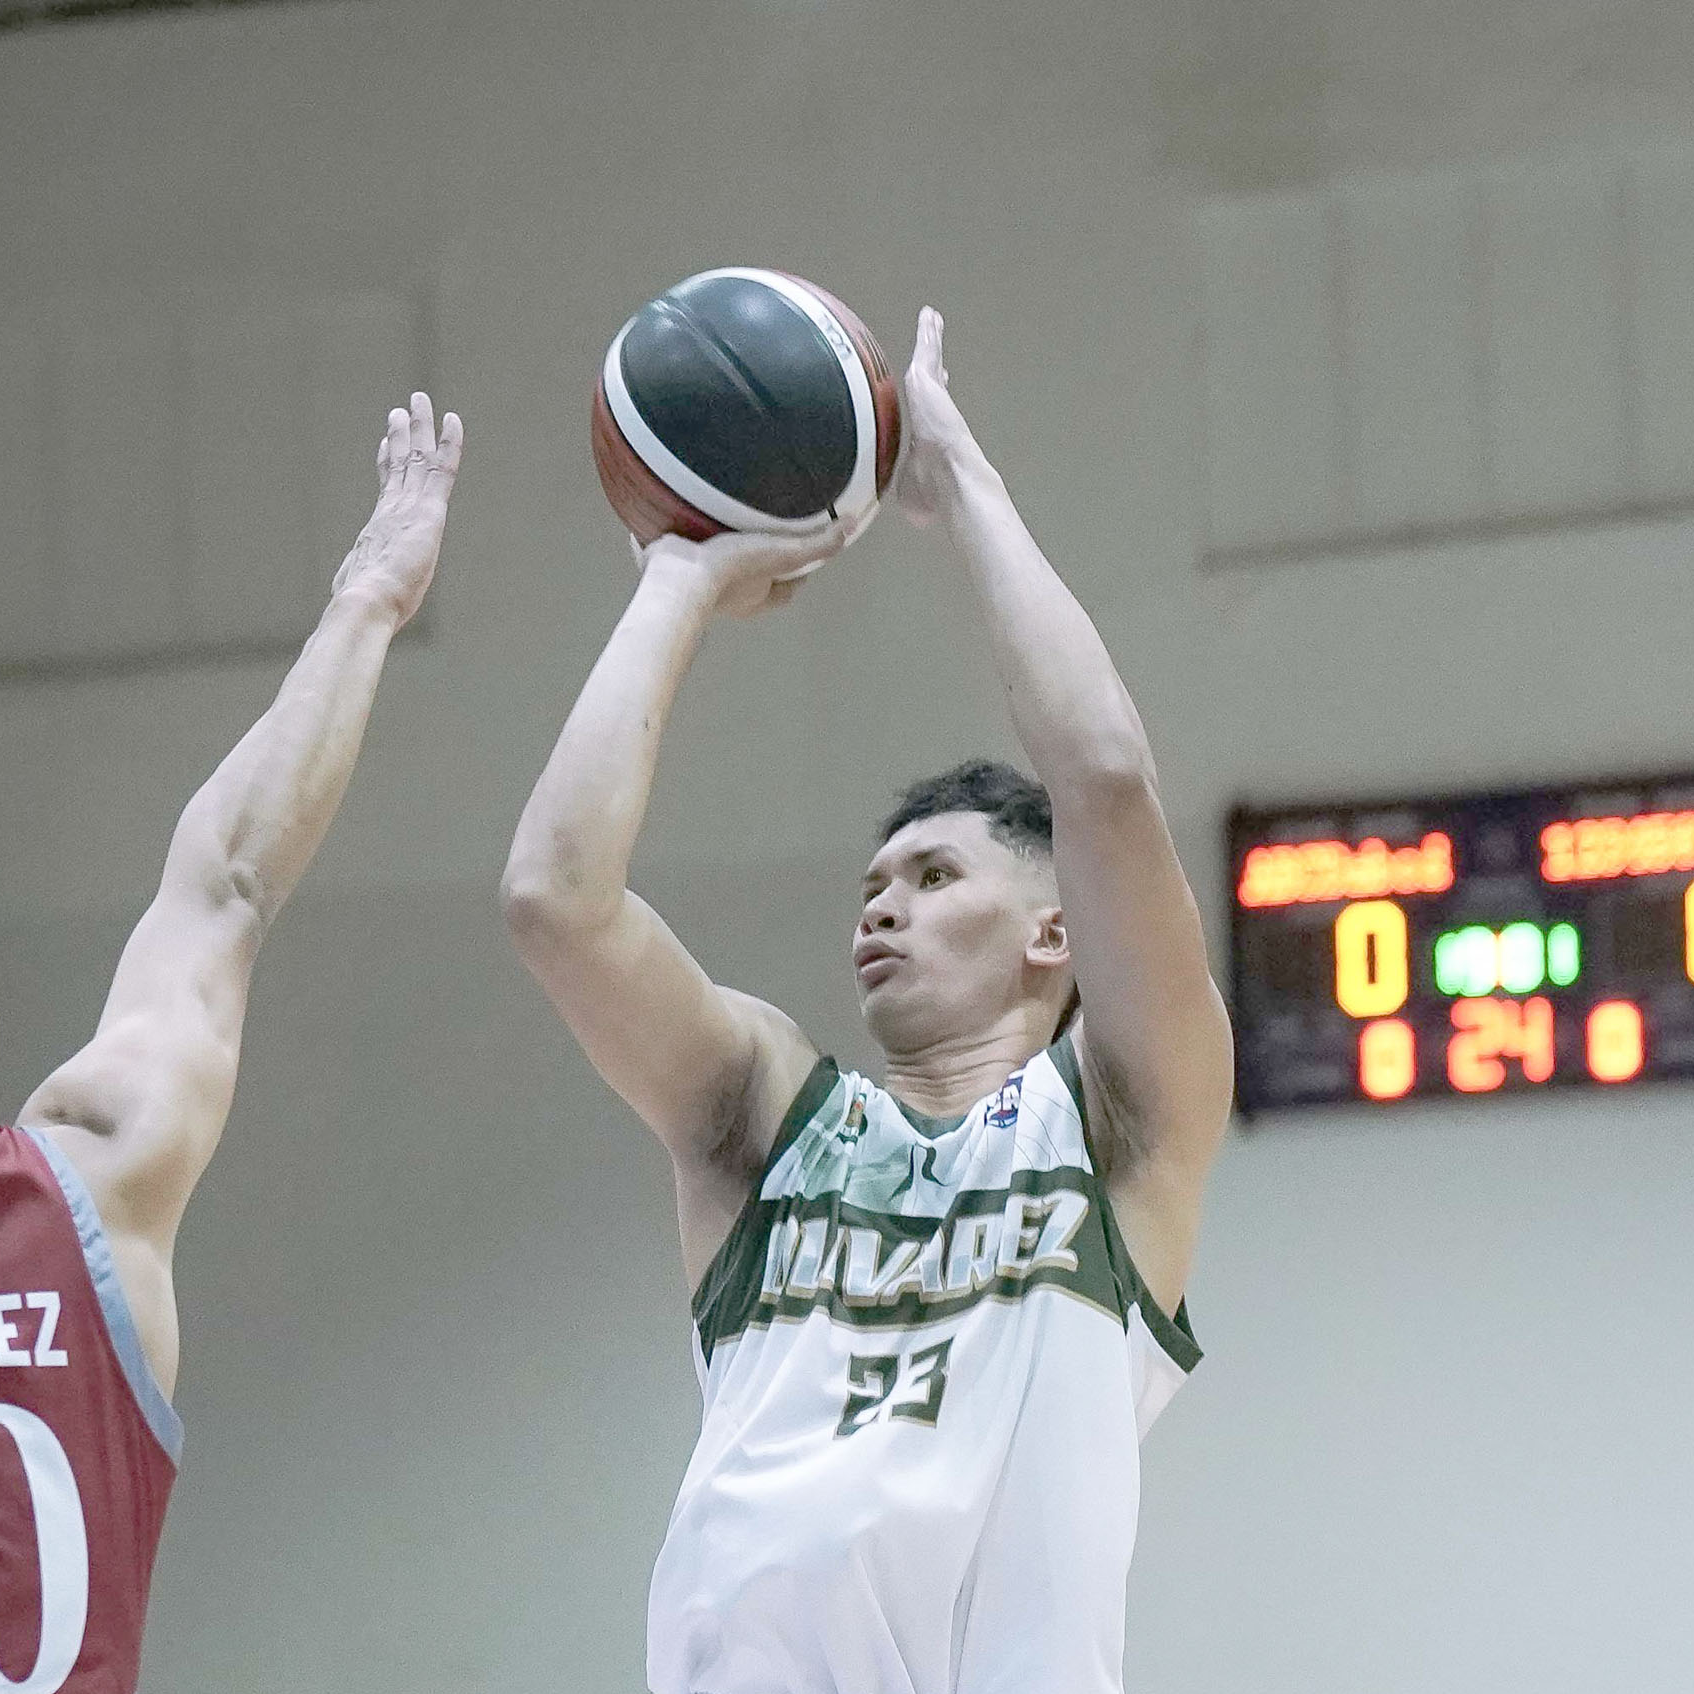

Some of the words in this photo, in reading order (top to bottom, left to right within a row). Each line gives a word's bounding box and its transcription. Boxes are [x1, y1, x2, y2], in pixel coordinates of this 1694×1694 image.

[1335, 900, 1408, 1018] 0
[1448, 996, 1555, 1092] 24
[832, 1333, 957, 1440] 23
